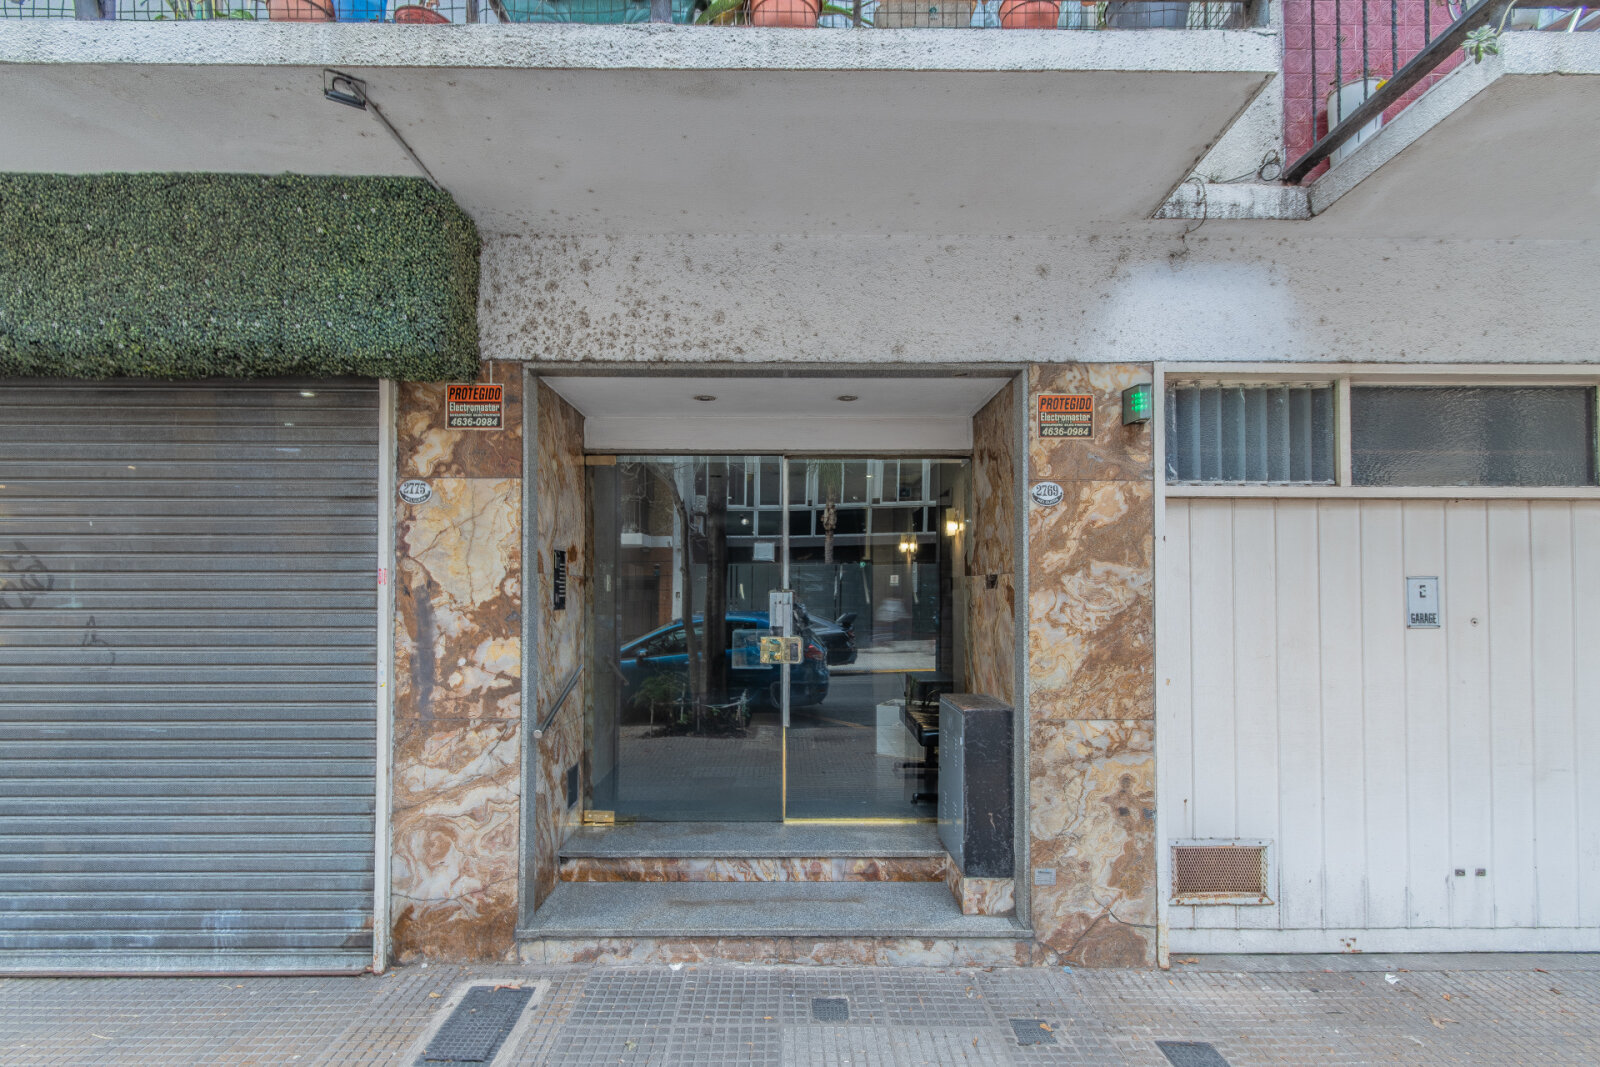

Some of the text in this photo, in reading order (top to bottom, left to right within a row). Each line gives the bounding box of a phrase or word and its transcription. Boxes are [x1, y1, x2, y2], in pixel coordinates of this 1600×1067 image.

[449, 387, 501, 400] PROTEGIDO
[450, 402, 500, 413] Electromaster
[1040, 397, 1092, 410] PROTEGIDO
[451, 418, 498, 426] 4636-0984
[1041, 412, 1091, 422] Electromaster
[1042, 427, 1089, 436] 4636-0984
[403, 482, 426, 495] 2775
[1036, 484, 1059, 496] 2769
[1410, 612, 1437, 624] GARAGE
